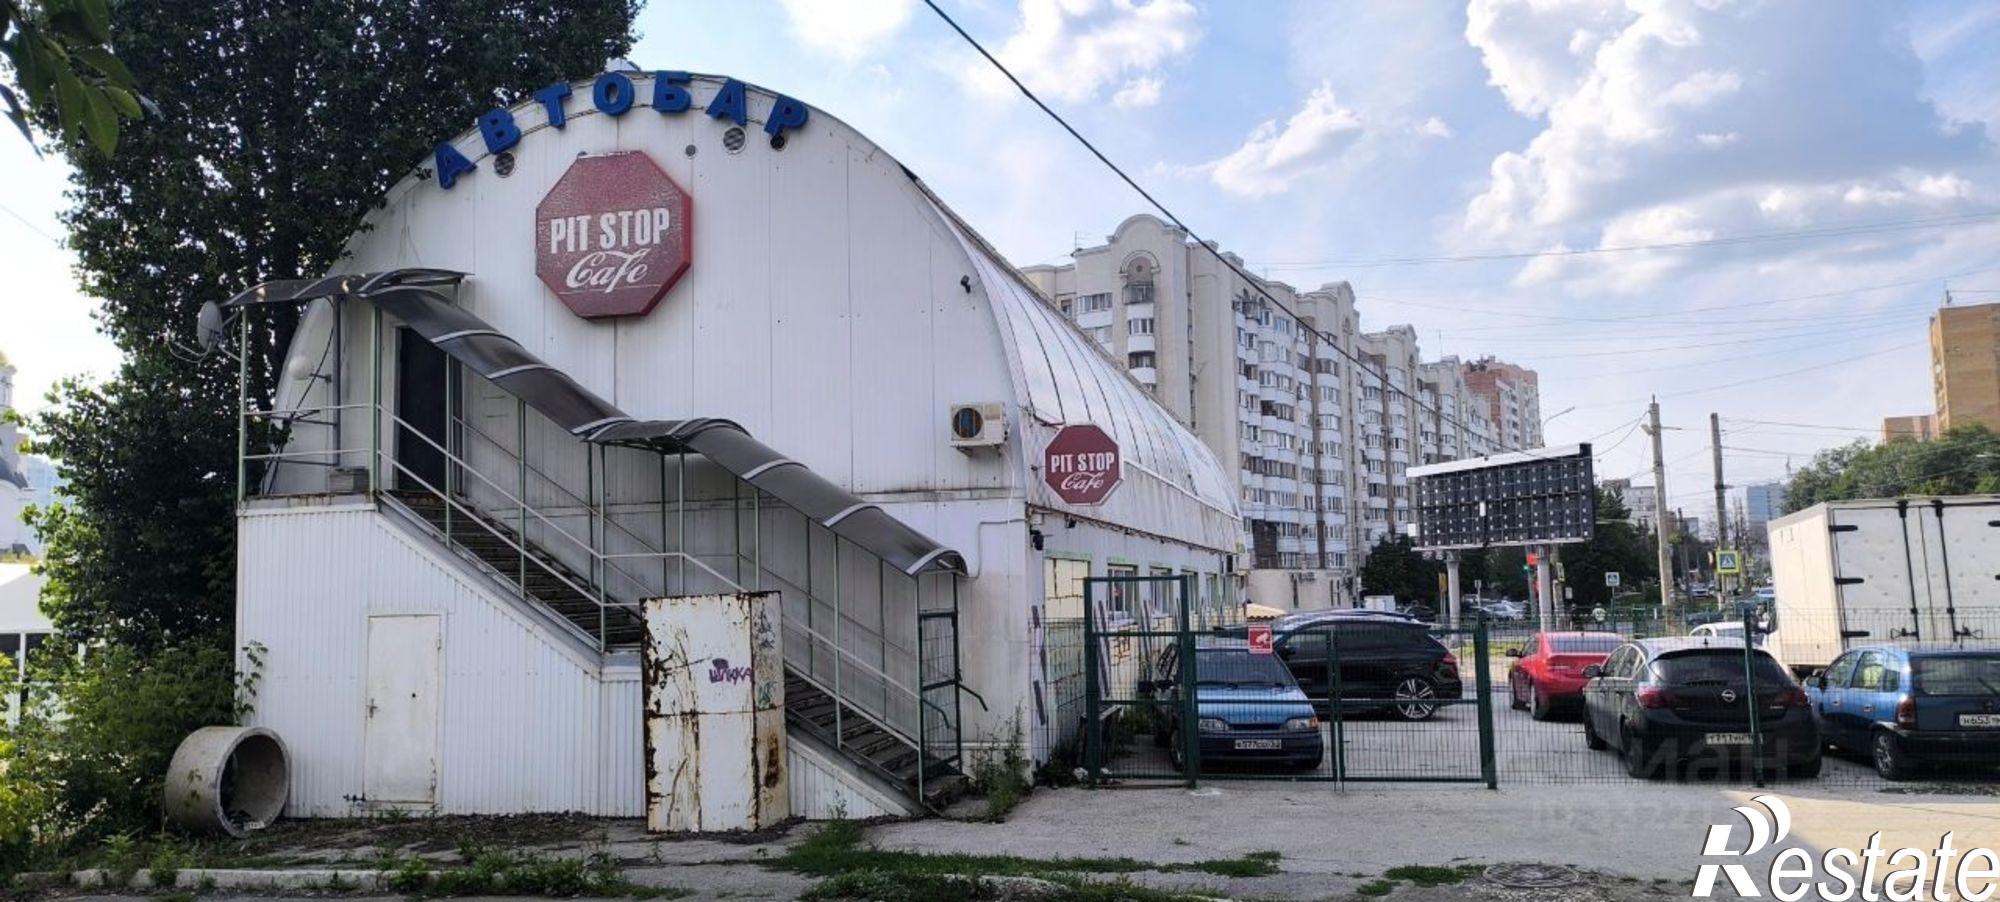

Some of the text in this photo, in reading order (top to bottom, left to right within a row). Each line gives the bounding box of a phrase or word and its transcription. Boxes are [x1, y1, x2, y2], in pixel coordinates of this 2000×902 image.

[434, 70, 810, 190] АВТОБАР
[550, 207, 670, 254] PIT STOP
[565, 248, 651, 293] Cafe
[1051, 451, 1115, 473] PIT STOP
[1061, 471, 1106, 493] Cafe
